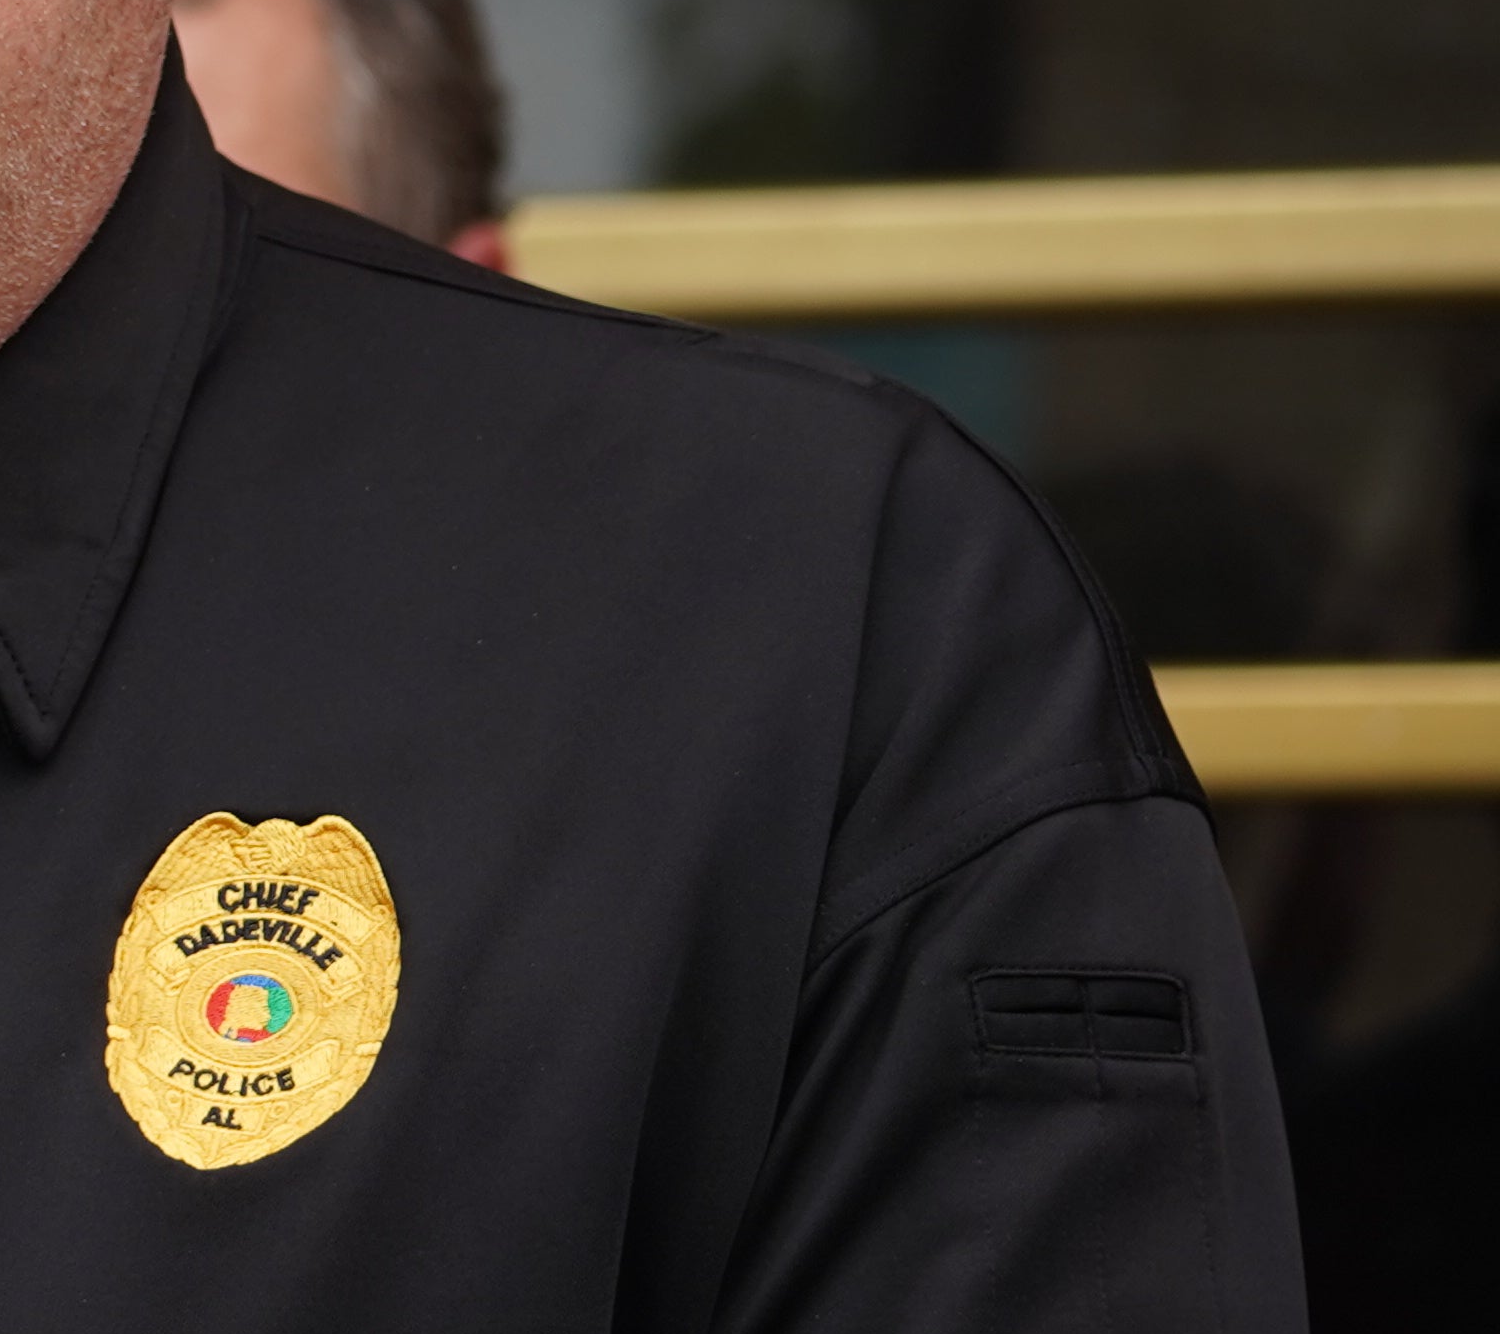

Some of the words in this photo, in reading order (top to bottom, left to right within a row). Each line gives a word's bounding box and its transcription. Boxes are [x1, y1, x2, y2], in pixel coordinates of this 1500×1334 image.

[217, 881, 320, 914] CHIEF
[176, 918, 344, 971] DADEVILLE
[168, 1058, 296, 1097] POLICE
[202, 1106, 242, 1130] AL
